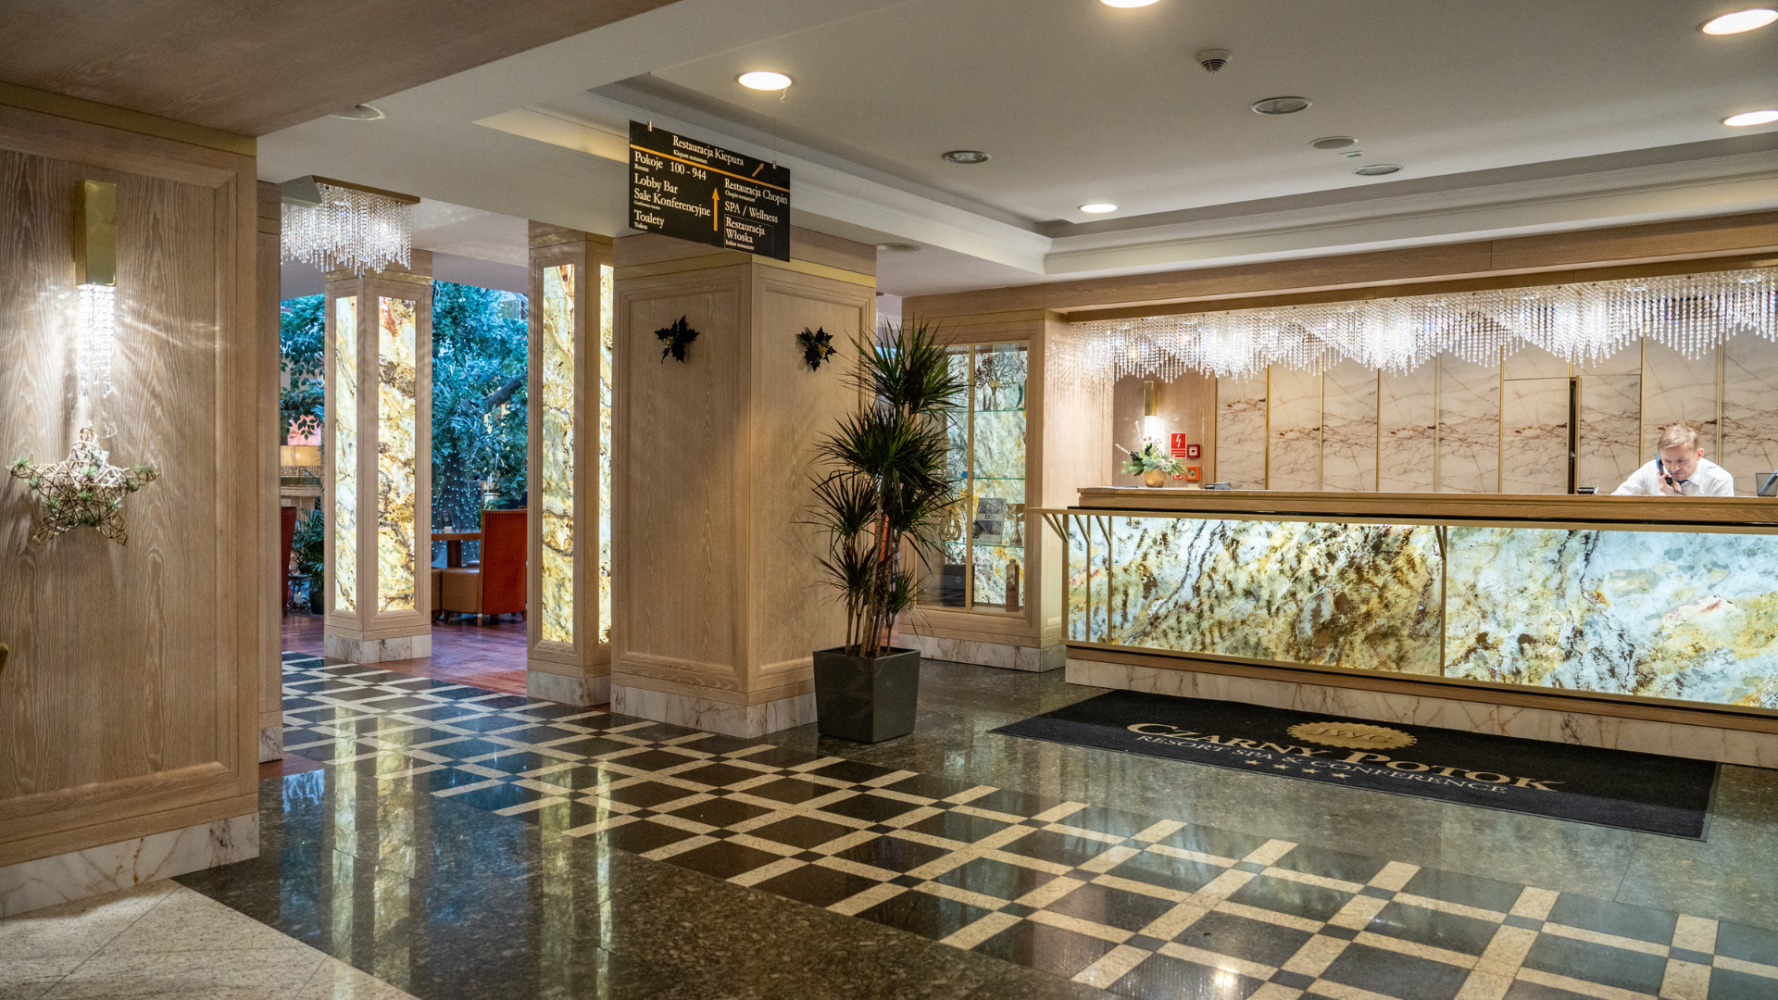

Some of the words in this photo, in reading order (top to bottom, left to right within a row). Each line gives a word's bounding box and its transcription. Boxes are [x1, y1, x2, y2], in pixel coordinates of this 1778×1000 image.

[673, 135, 714, 159] Restauracja
[715, 148, 744, 166] Kiepura
[635, 151, 664, 171] Pokoje
[670, 161, 685, 175] 100
[692, 167, 707, 181] 944
[634, 173, 662, 192] Lobby
[663, 180, 678, 194] Bar
[725, 178, 761, 199] Restauracja
[762, 189, 788, 206] Chopin
[634, 188, 652, 202] Sale
[653, 193, 711, 217] Konferencyjne
[725, 201, 740, 214] SPA
[748, 206, 778, 223] Wellness
[634, 209, 665, 229] Toalety
[726, 216, 765, 237] Restauracja
[1126, 723, 1333, 758] CZARNY
[1336, 751, 1565, 792] POTOK
[1136, 735, 1230, 752] RESORT
[1231, 749, 1273, 760] SPA
[1310, 760, 1508, 794] CONFERENCE
